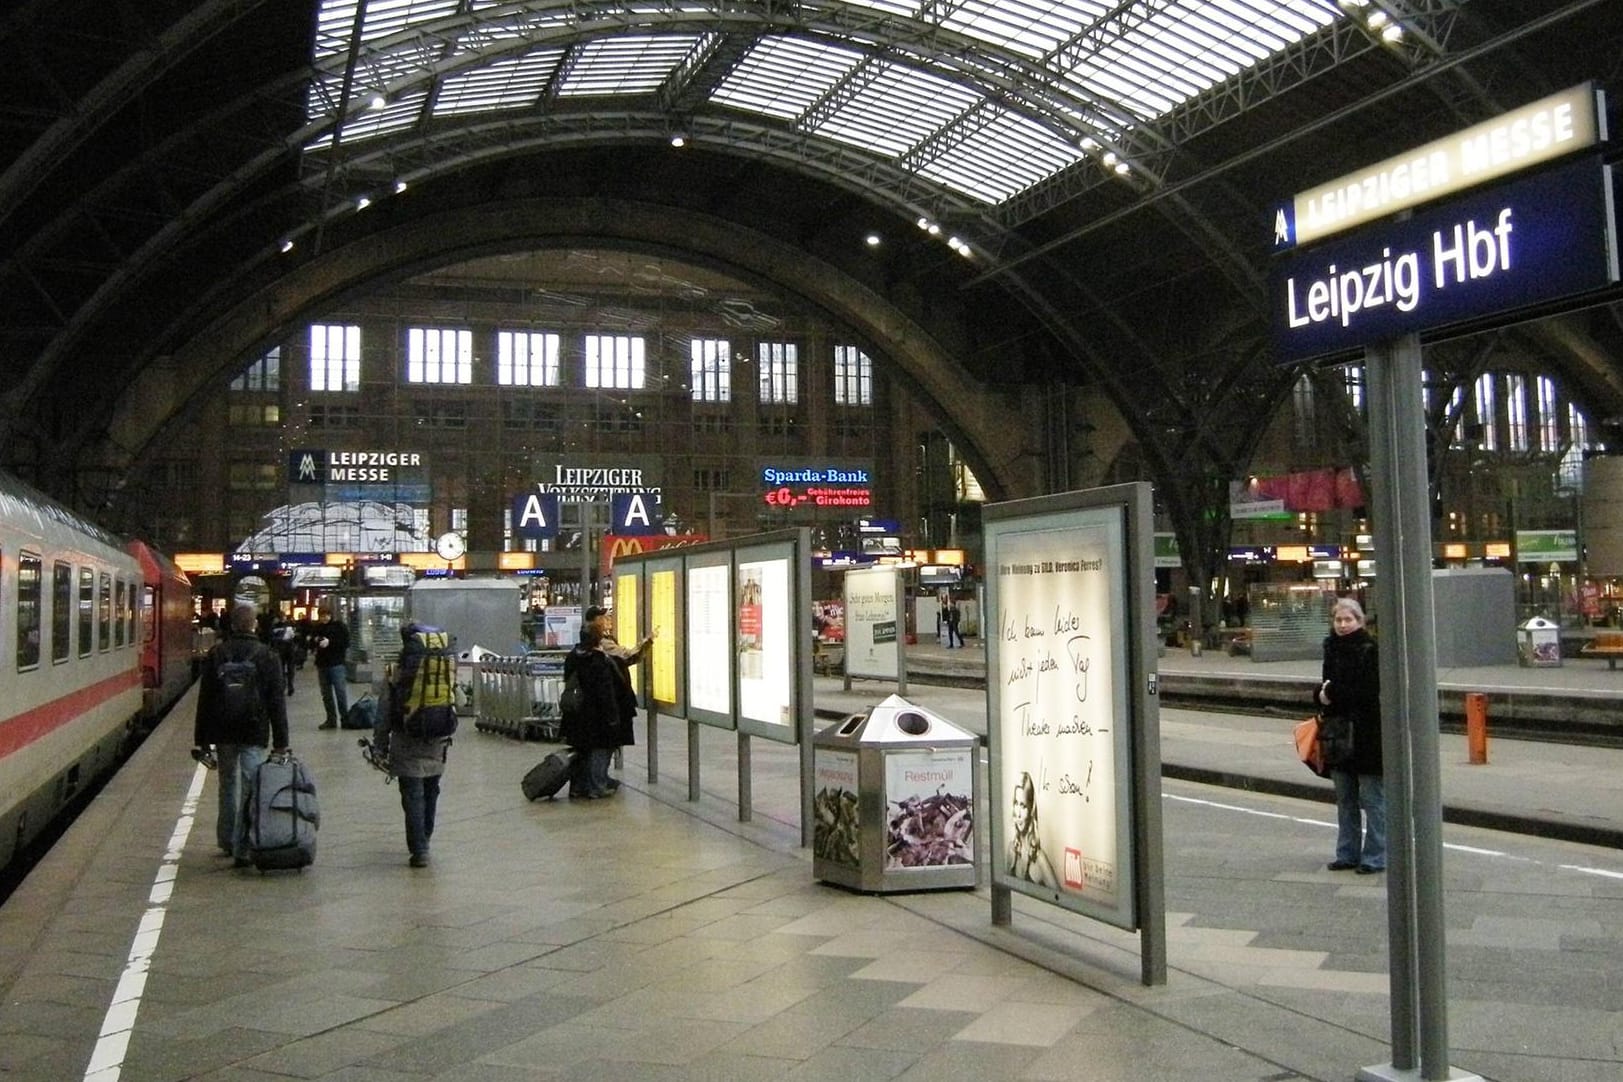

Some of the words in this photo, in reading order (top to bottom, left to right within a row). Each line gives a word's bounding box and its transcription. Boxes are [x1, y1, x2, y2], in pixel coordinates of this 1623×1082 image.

[1307, 151, 1450, 230] LEIPZIGER
[1460, 103, 1574, 176] MESSE
[1287, 247, 1421, 329] Leipzig
[1432, 207, 1513, 290] Hbf
[330, 452, 421, 466] LEIPZIGER
[331, 468, 389, 481] MESSE
[555, 464, 643, 486] LEIPZIGER
[764, 468, 868, 484] Sparda-Bank
[816, 495, 870, 506] Girokonto
[519, 494, 547, 528] A
[624, 494, 650, 527] A
[904, 769, 954, 782] Restmüll
